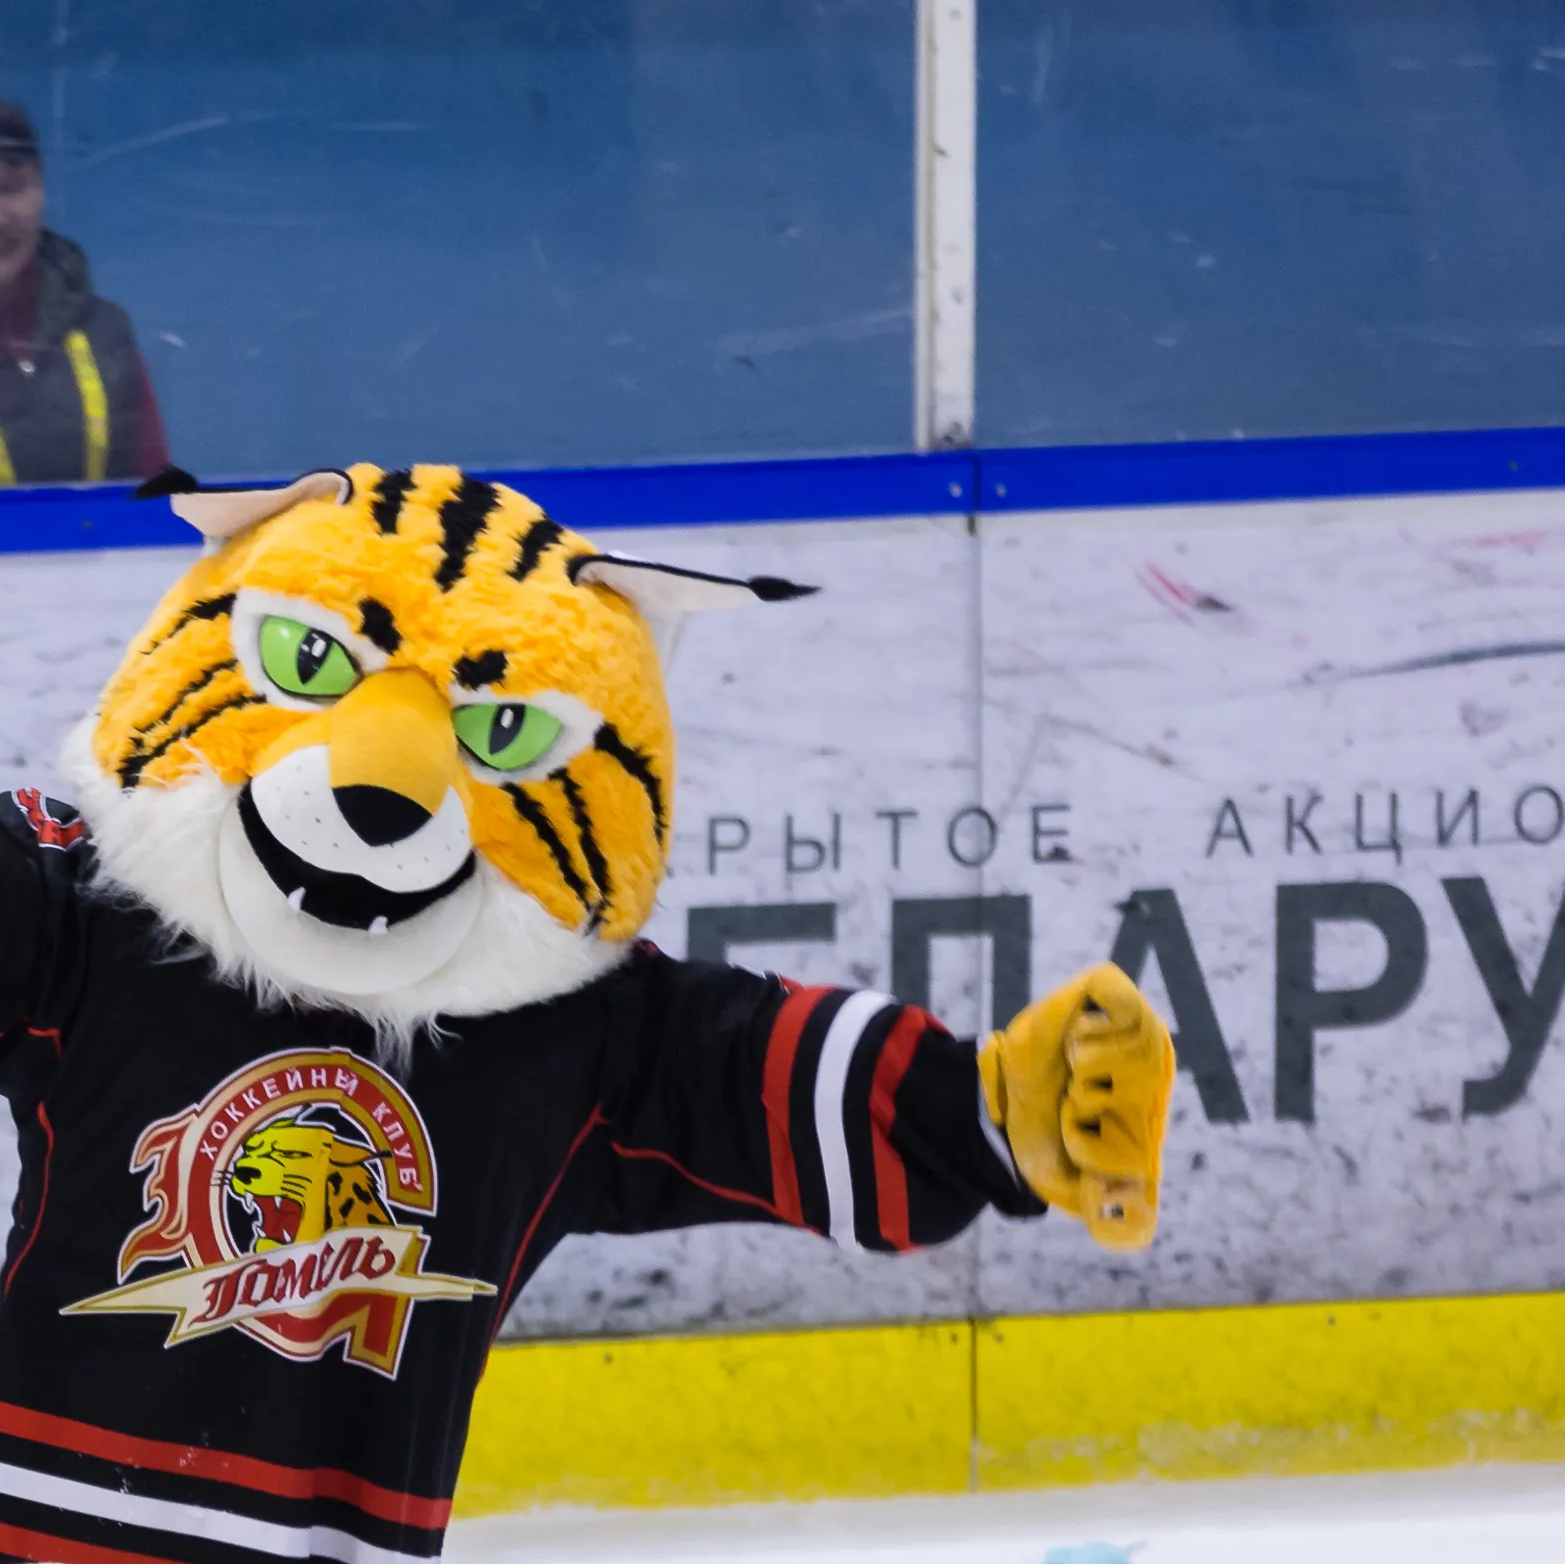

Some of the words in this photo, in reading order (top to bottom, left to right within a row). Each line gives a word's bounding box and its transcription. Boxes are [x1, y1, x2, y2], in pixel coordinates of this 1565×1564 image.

[668, 803, 1072, 877] РЫТОЕ
[1206, 784, 1564, 866] АКЦИО
[372, 1101, 422, 1192] КЛУБ
